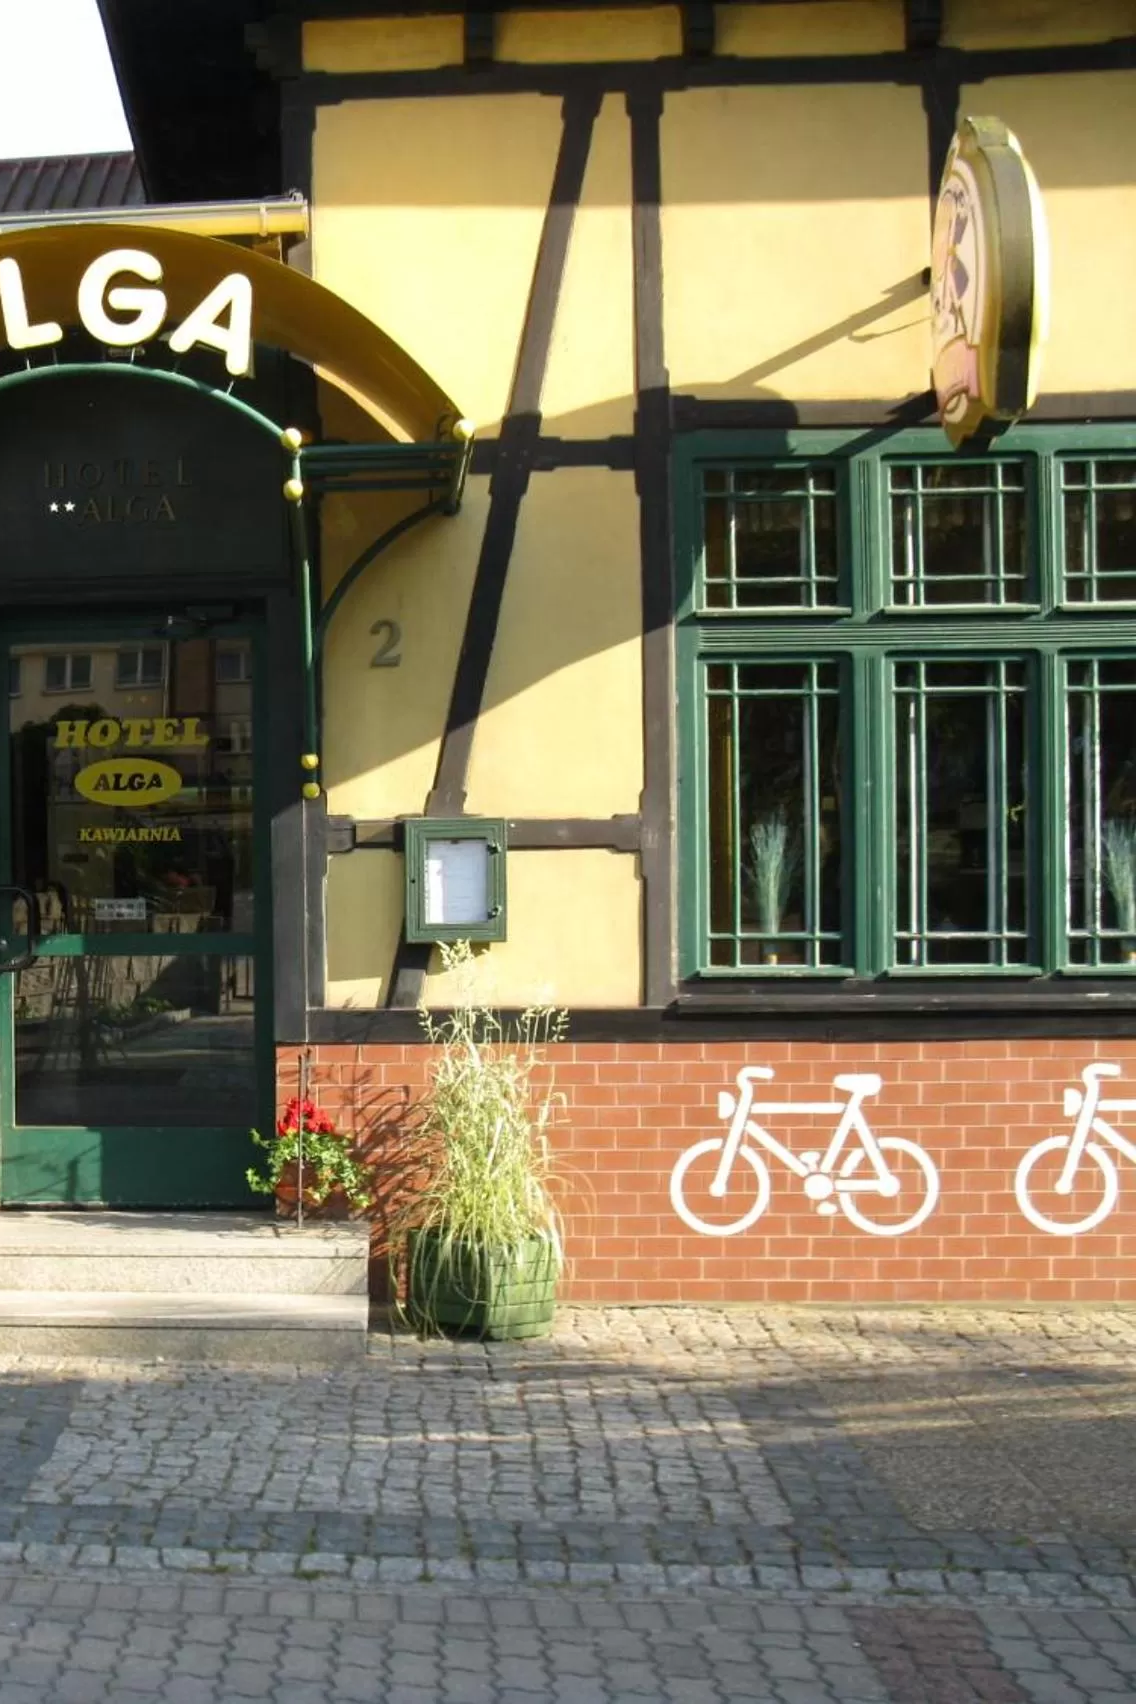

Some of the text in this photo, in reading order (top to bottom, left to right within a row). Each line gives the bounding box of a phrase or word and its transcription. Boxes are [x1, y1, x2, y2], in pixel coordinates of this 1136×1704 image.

[42, 457, 193, 489] HOTEL
[81, 495, 177, 526] ALGA
[369, 619, 402, 668] 2
[54, 717, 210, 749] HOTEL
[93, 773, 163, 791] ALGA
[79, 827, 182, 842] KAWIARNIA
